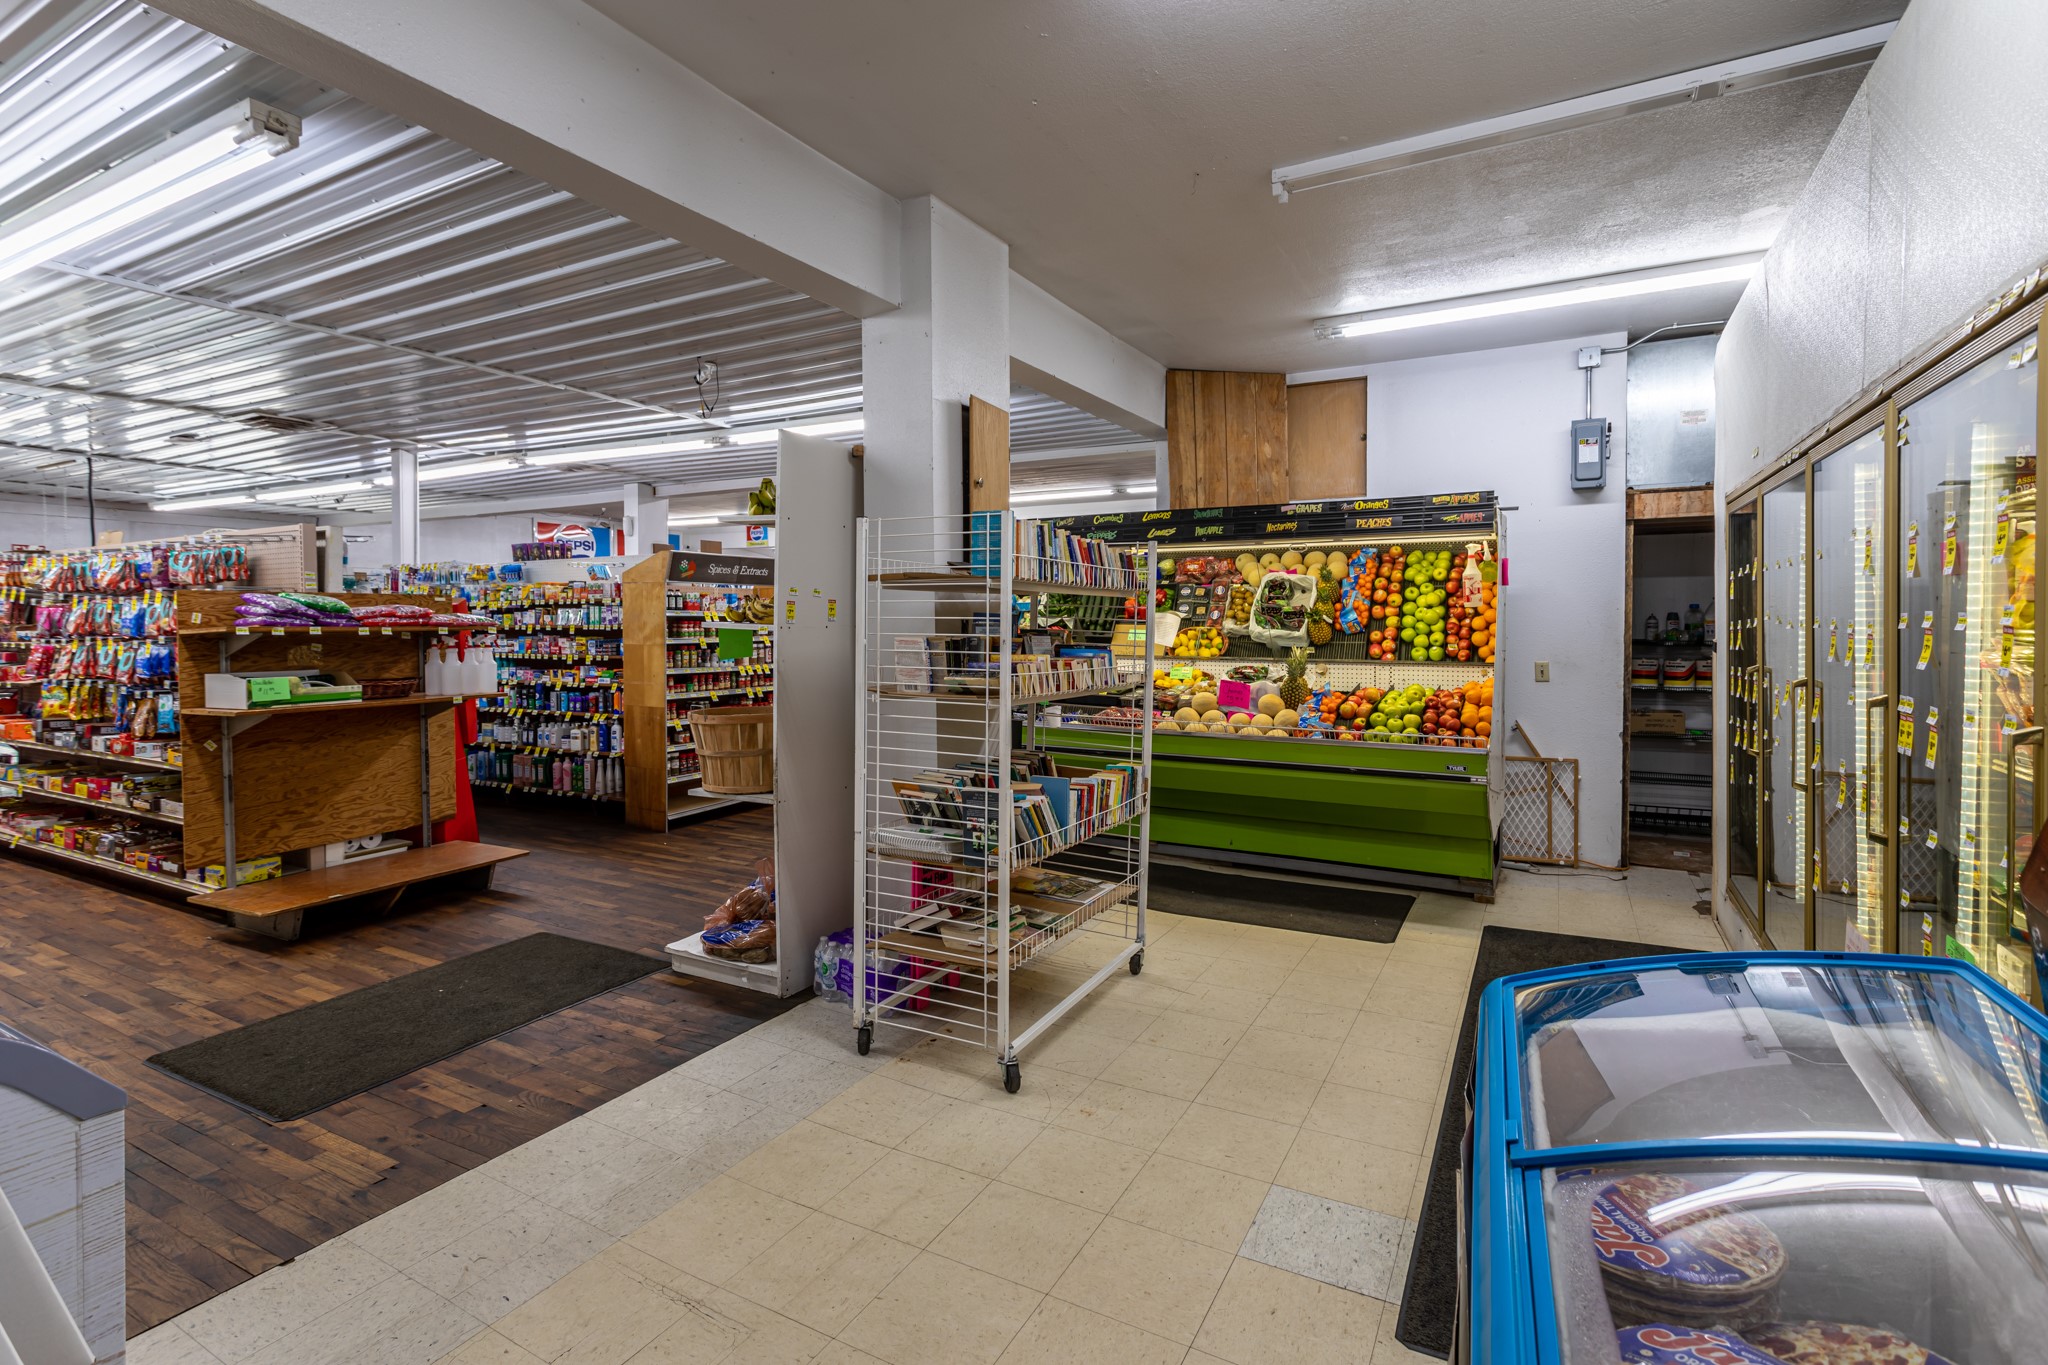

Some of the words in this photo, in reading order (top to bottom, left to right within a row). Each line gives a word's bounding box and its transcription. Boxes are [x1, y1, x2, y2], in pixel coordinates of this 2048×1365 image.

[1296, 503, 1323, 514] GRAPES
[1354, 499, 1389, 511] Oranges
[1142, 511, 1172, 522] Lemons
[1356, 516, 1392, 529] PEACHES
[1147, 527, 1177, 538] LIMES
[1194, 525, 1224, 537] PINEAPPLE
[1265, 521, 1298, 534] Nectarines
[708, 563, 731, 576] Spices
[732, 564, 740, 575] &
[739, 565, 769, 577] Extracts
[1611, 1210, 1655, 1243] ORIGINAL
